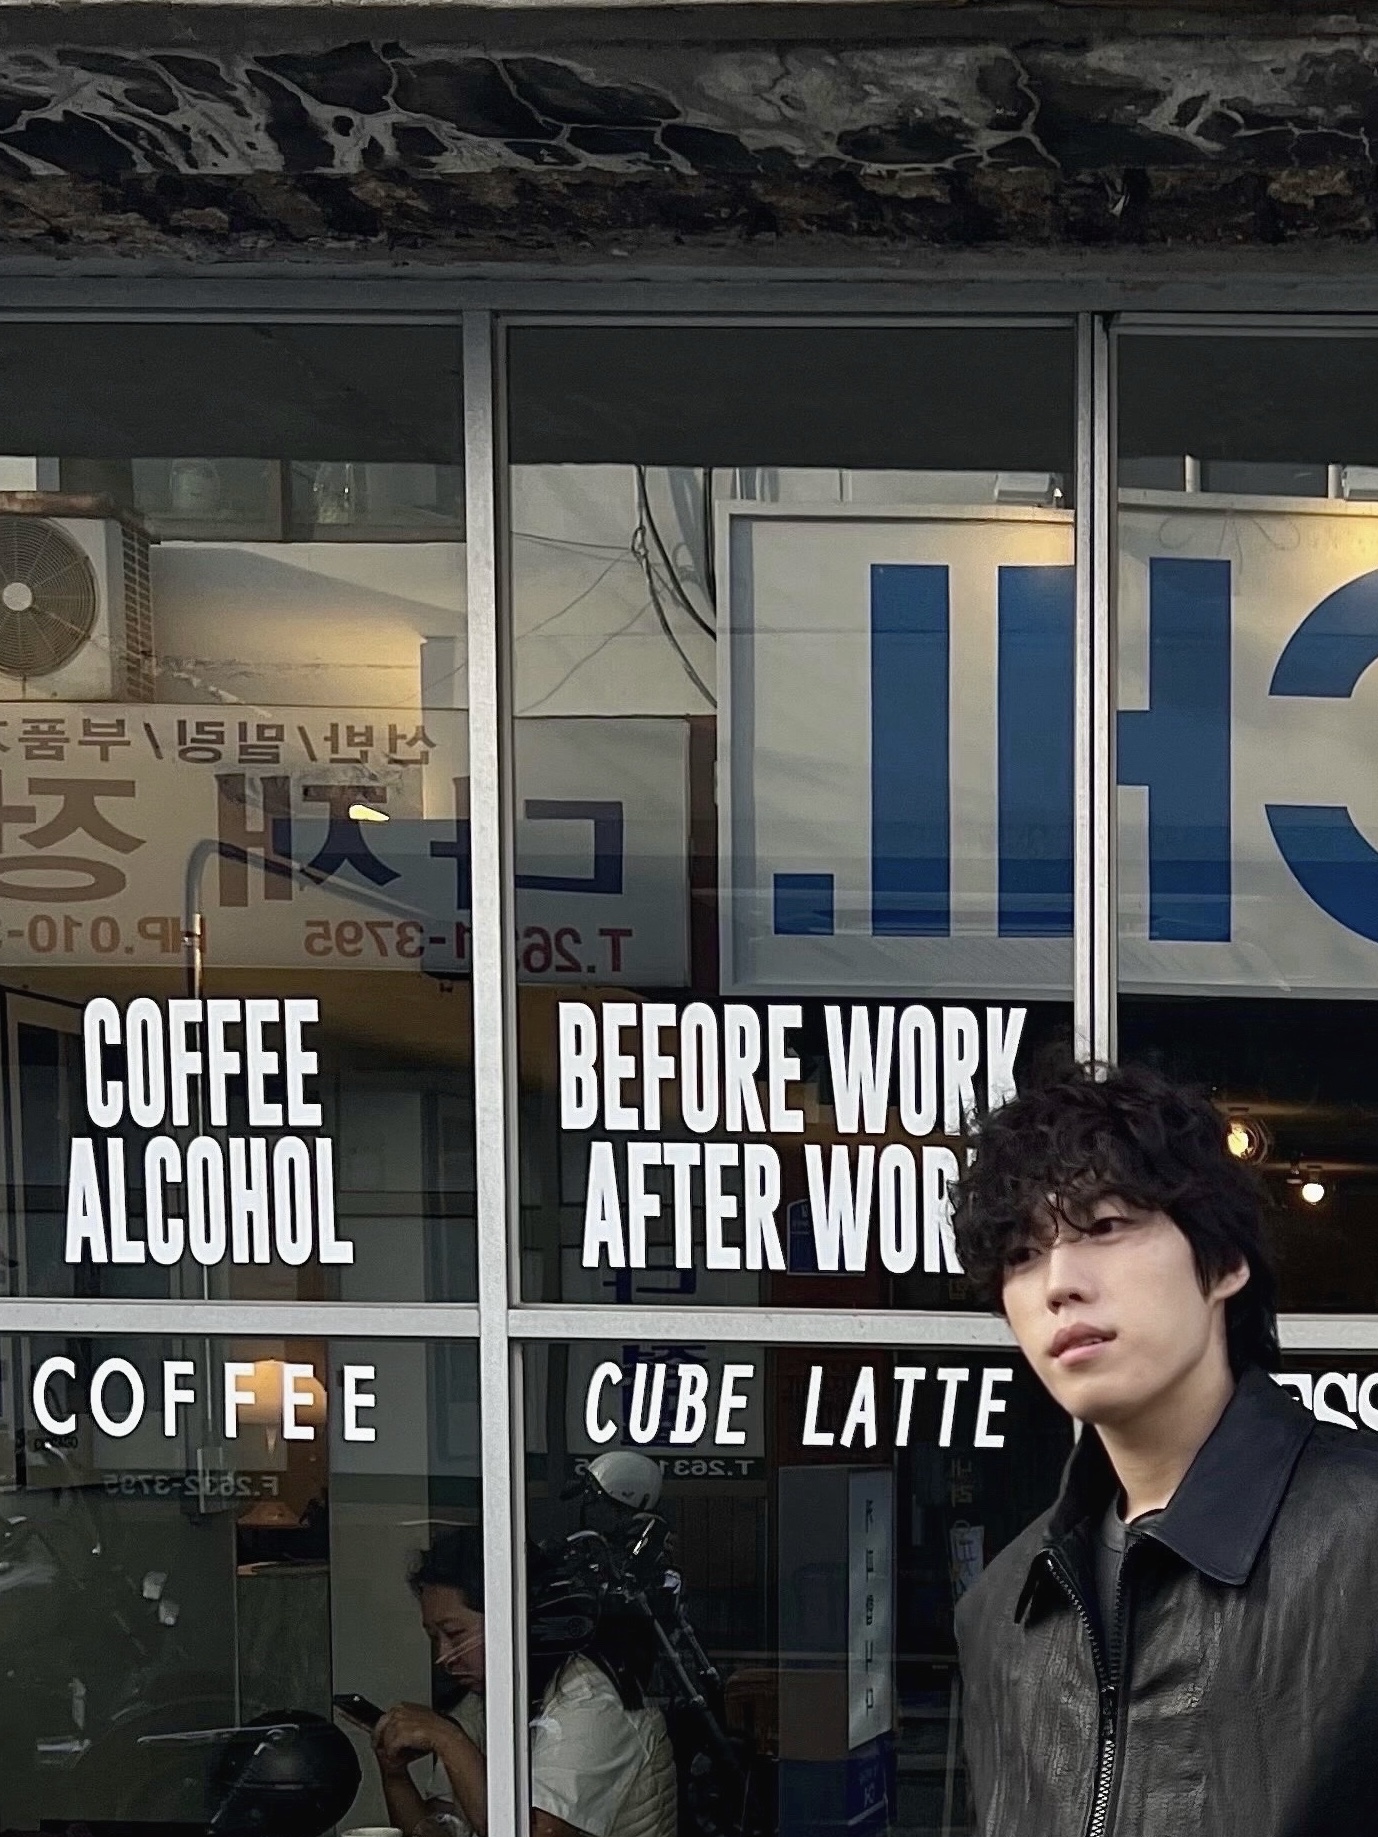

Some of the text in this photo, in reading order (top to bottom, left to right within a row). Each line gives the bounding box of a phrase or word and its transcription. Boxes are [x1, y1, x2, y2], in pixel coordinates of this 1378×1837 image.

[83, 997, 323, 1128] COFFEE
[558, 1001, 1028, 1136] BEFORE WORK
[65, 1135, 354, 1265] ALCOHOL
[582, 1141, 978, 1274] AFTER WOR
[32, 1356, 377, 1443] COFFEE
[585, 1362, 754, 1445] CUBE
[802, 1365, 1013, 1448] LATTE
